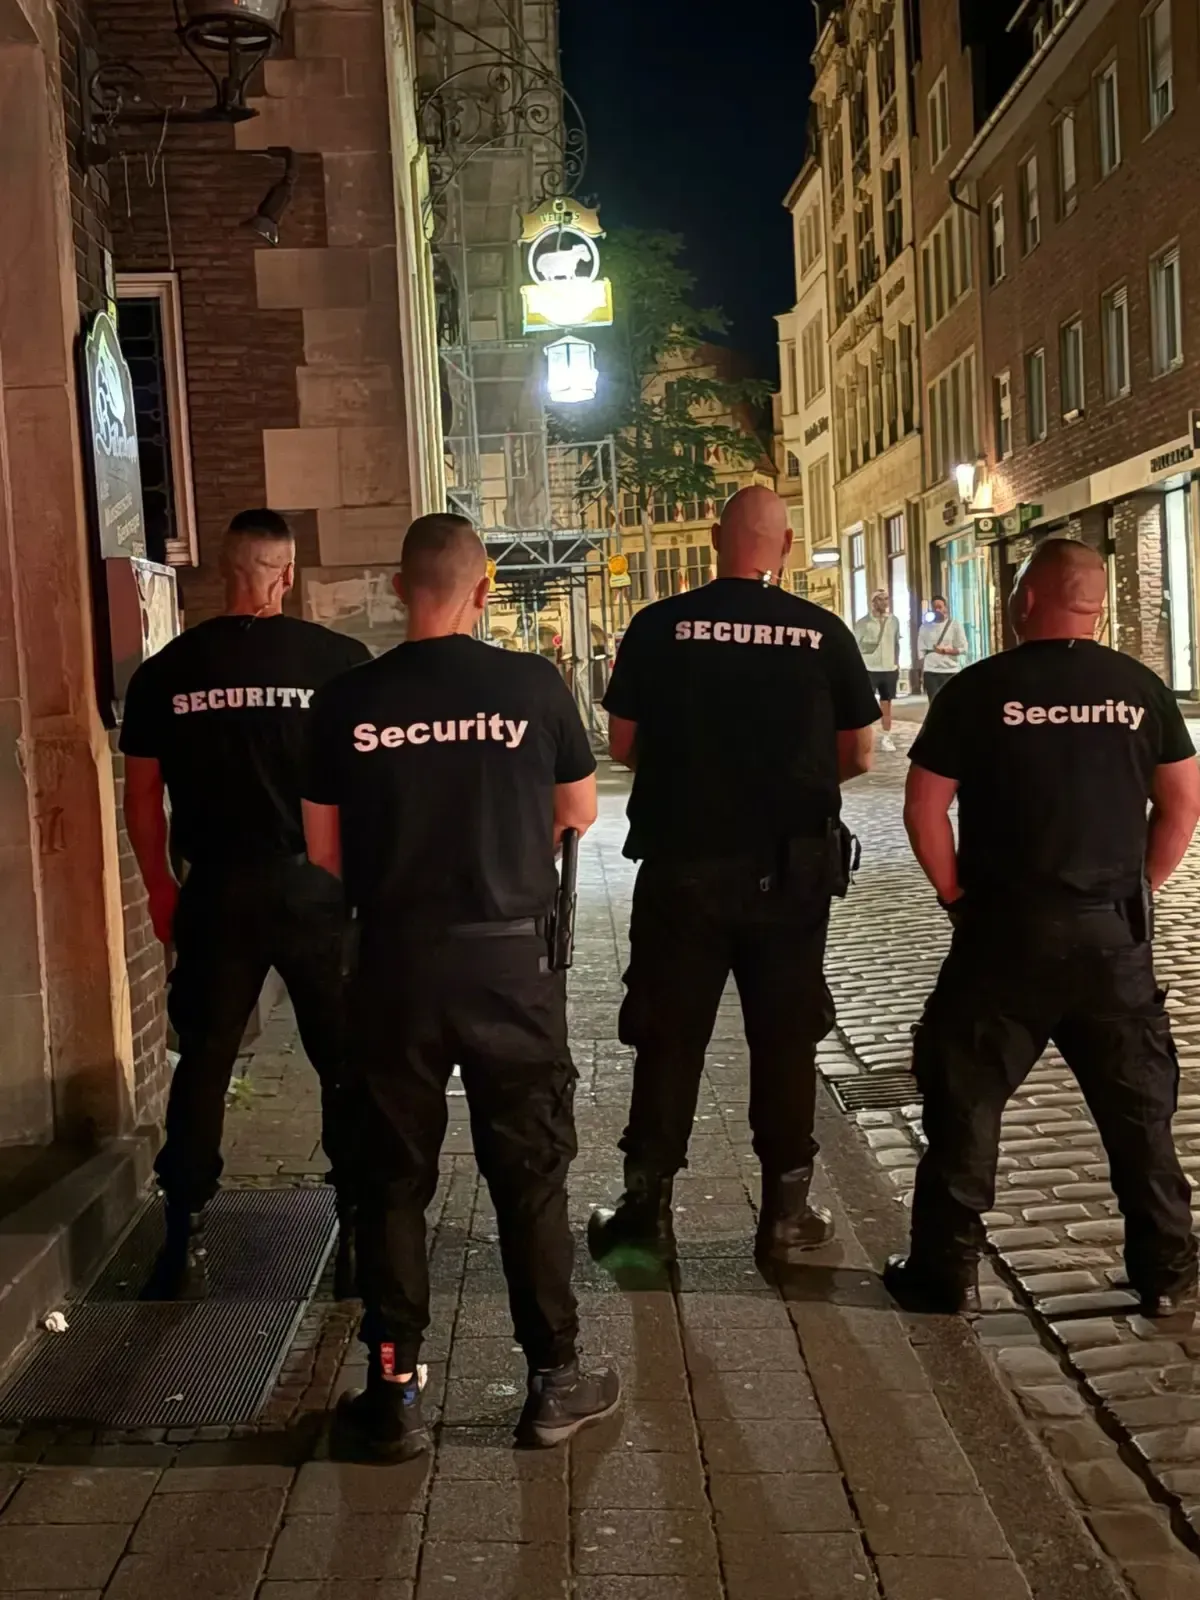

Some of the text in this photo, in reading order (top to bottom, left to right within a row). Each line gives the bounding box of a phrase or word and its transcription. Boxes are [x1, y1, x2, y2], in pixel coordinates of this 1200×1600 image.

[675, 620, 823, 650] SECURITY
[172, 686, 315, 714] SECURITY
[1003, 699, 1145, 732] Security
[353, 712, 529, 753] Security
